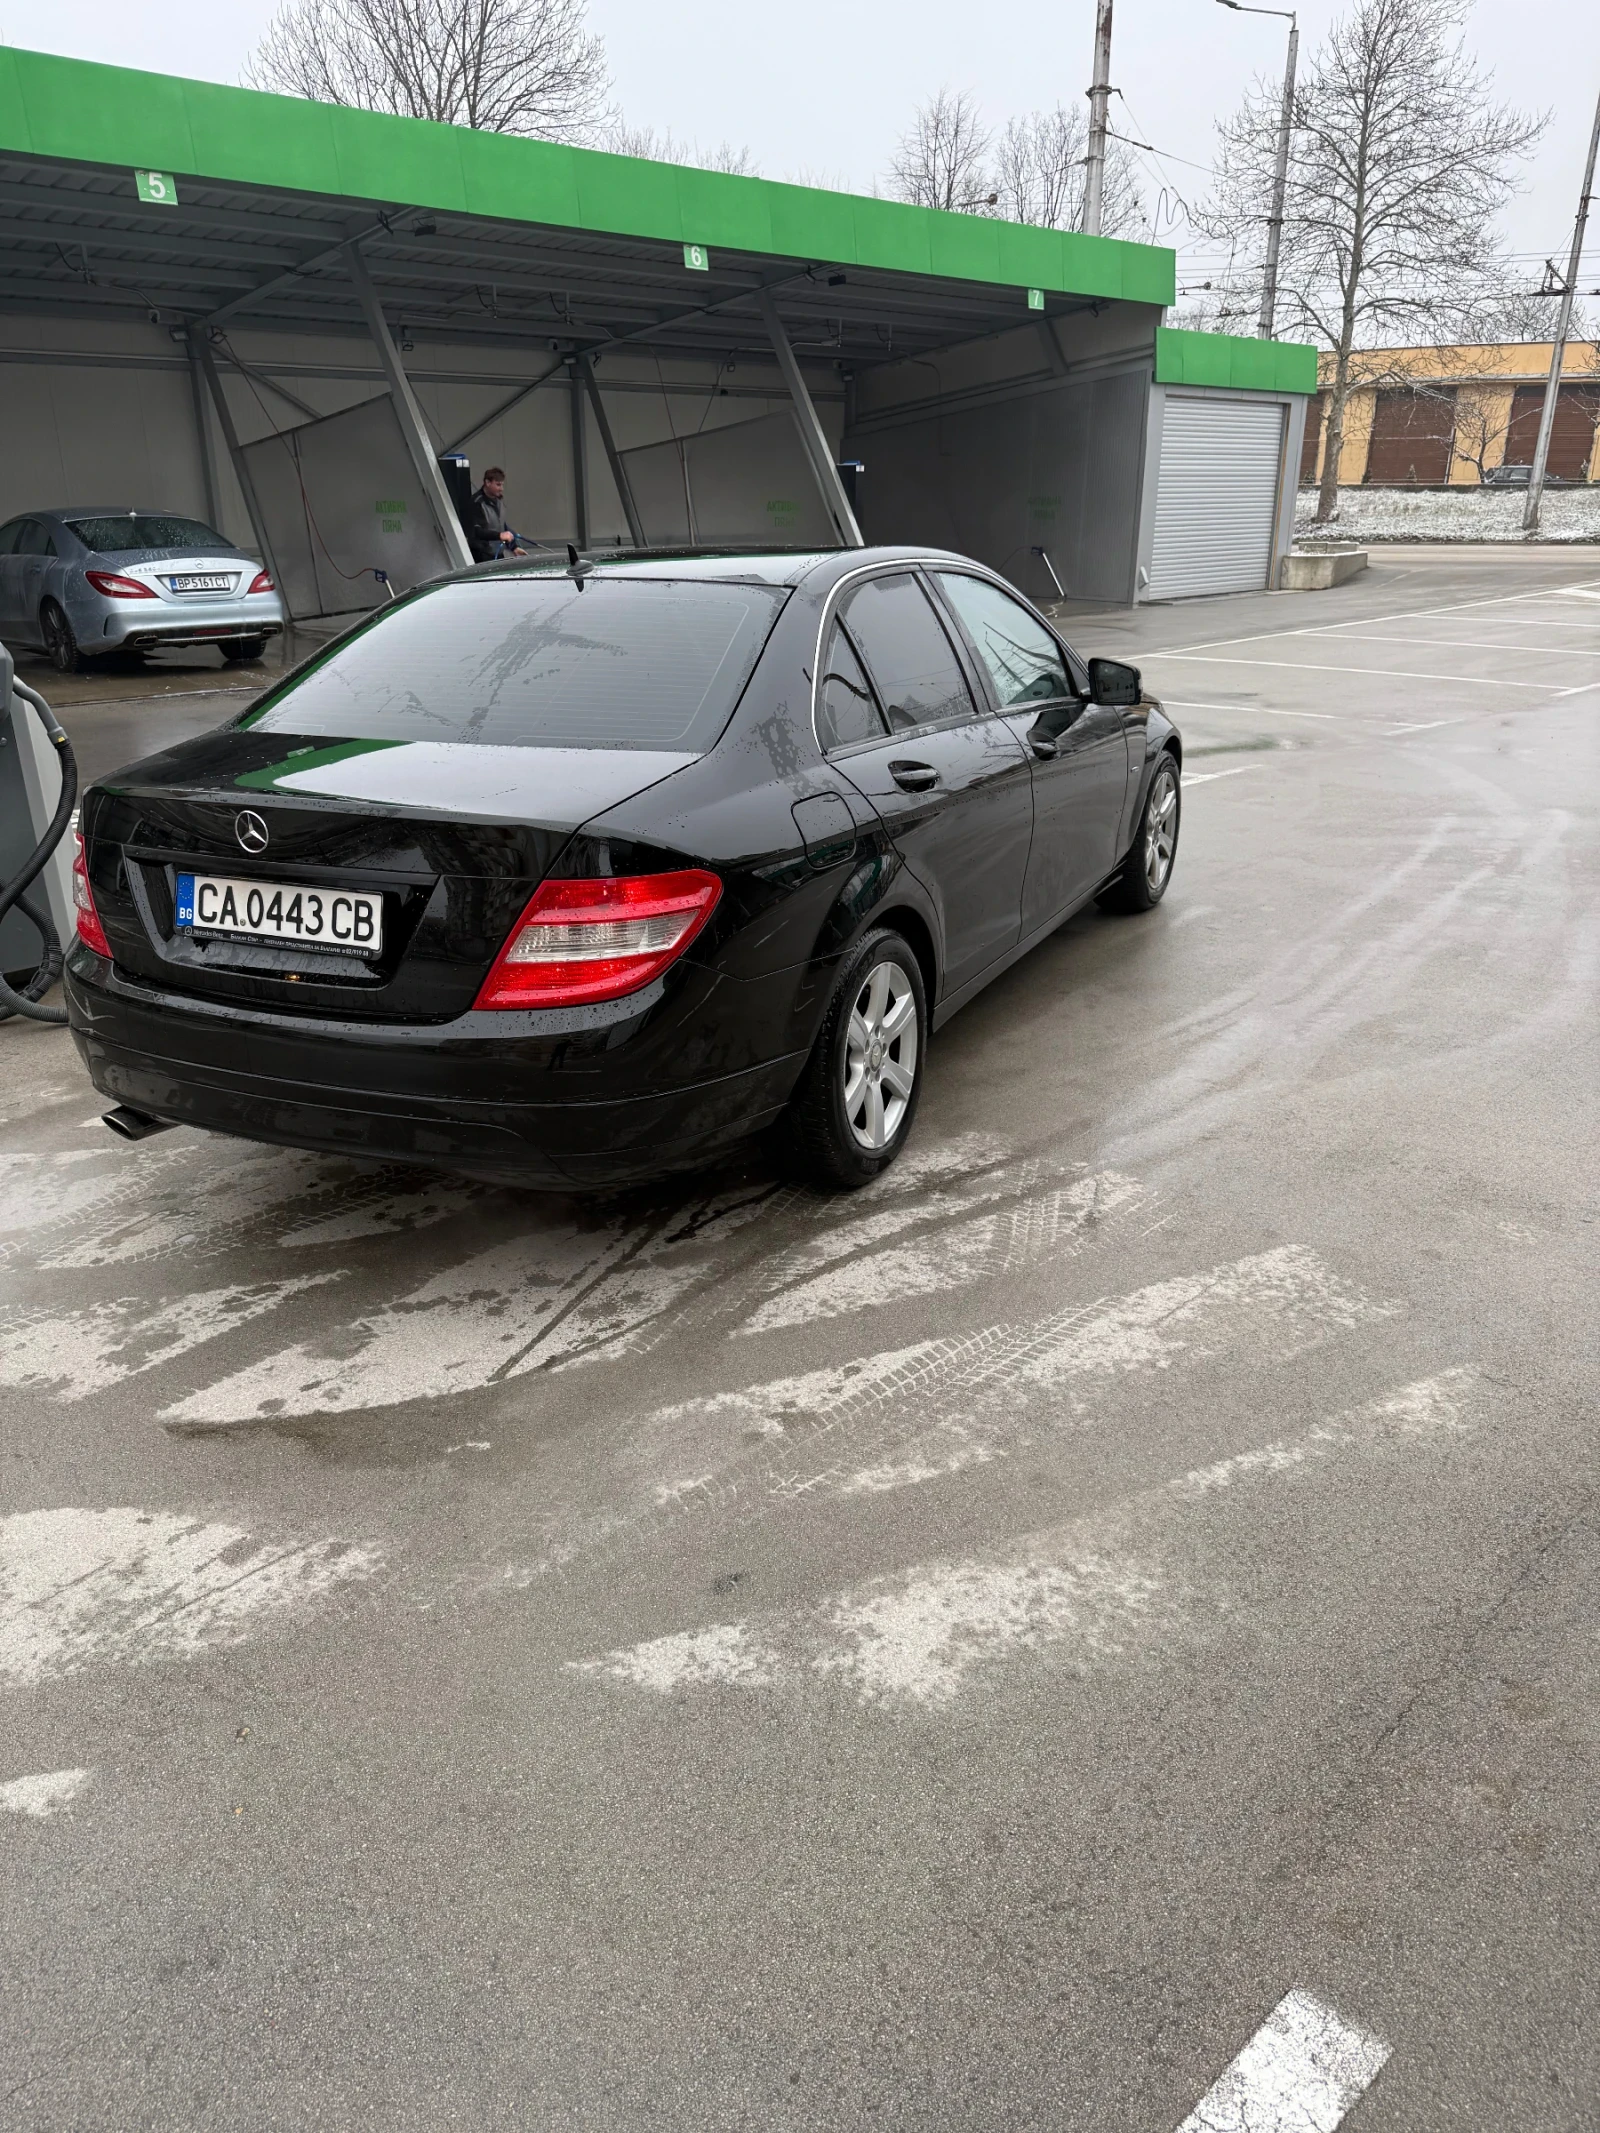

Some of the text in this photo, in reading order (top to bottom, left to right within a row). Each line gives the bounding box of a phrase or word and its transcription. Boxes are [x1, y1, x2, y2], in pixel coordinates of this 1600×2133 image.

[149, 172, 165, 198] 5
[691, 246, 701, 266] 6
[1033, 290, 1040, 306] 7
[177, 576, 227, 589] BP 5161 CT
[179, 907, 193, 920] BG
[198, 883, 374, 942] CA 0443 CB
